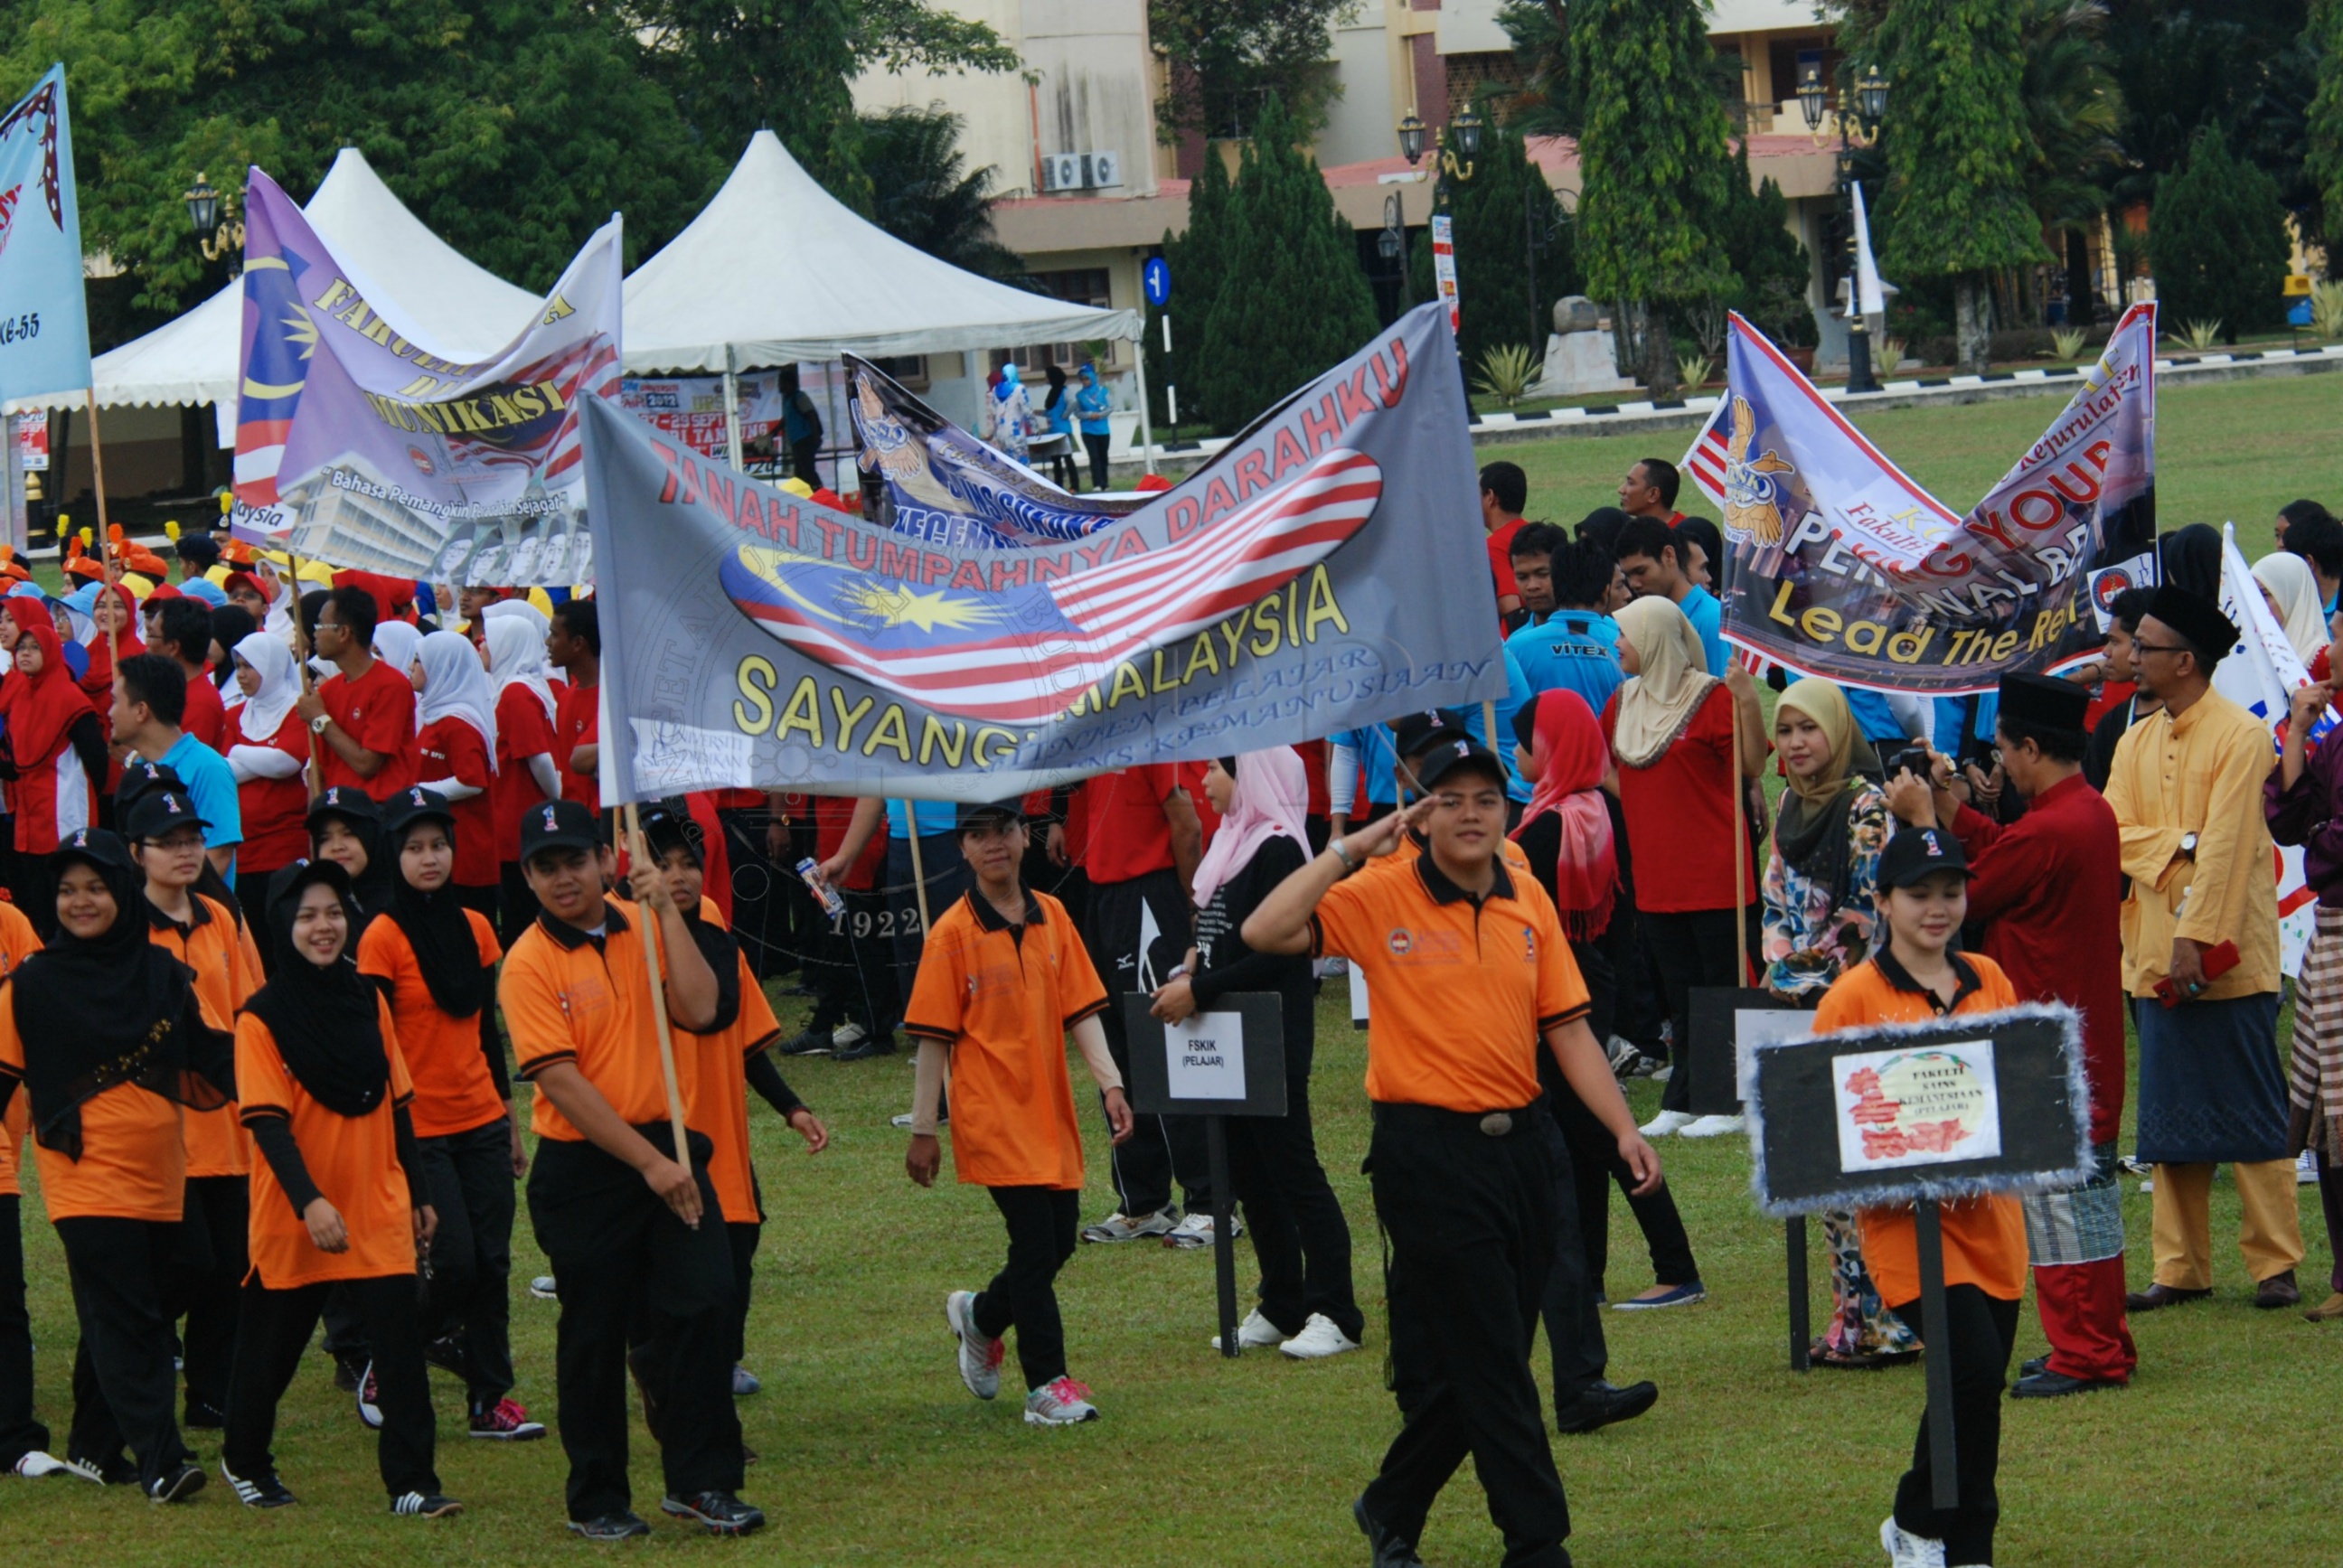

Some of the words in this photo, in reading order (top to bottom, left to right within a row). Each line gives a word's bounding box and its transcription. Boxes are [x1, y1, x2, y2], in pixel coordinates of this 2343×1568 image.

[647, 394, 677, 407] 2012
[650, 437, 798, 547] TANAH
[818, 517, 1150, 593] TUMPAHNYA
[1167, 337, 1410, 538] DARAHKU
[1769, 579, 1935, 665] Lead
[1941, 625, 2018, 667] The
[1145, 657, 1493, 755] KEMANUSIAAN
[1172, 646, 1383, 719] PELAJAR
[1182, 1055, 1225, 1069] (PELAJAR)
[1188, 1039, 1217, 1052] FSKIK
